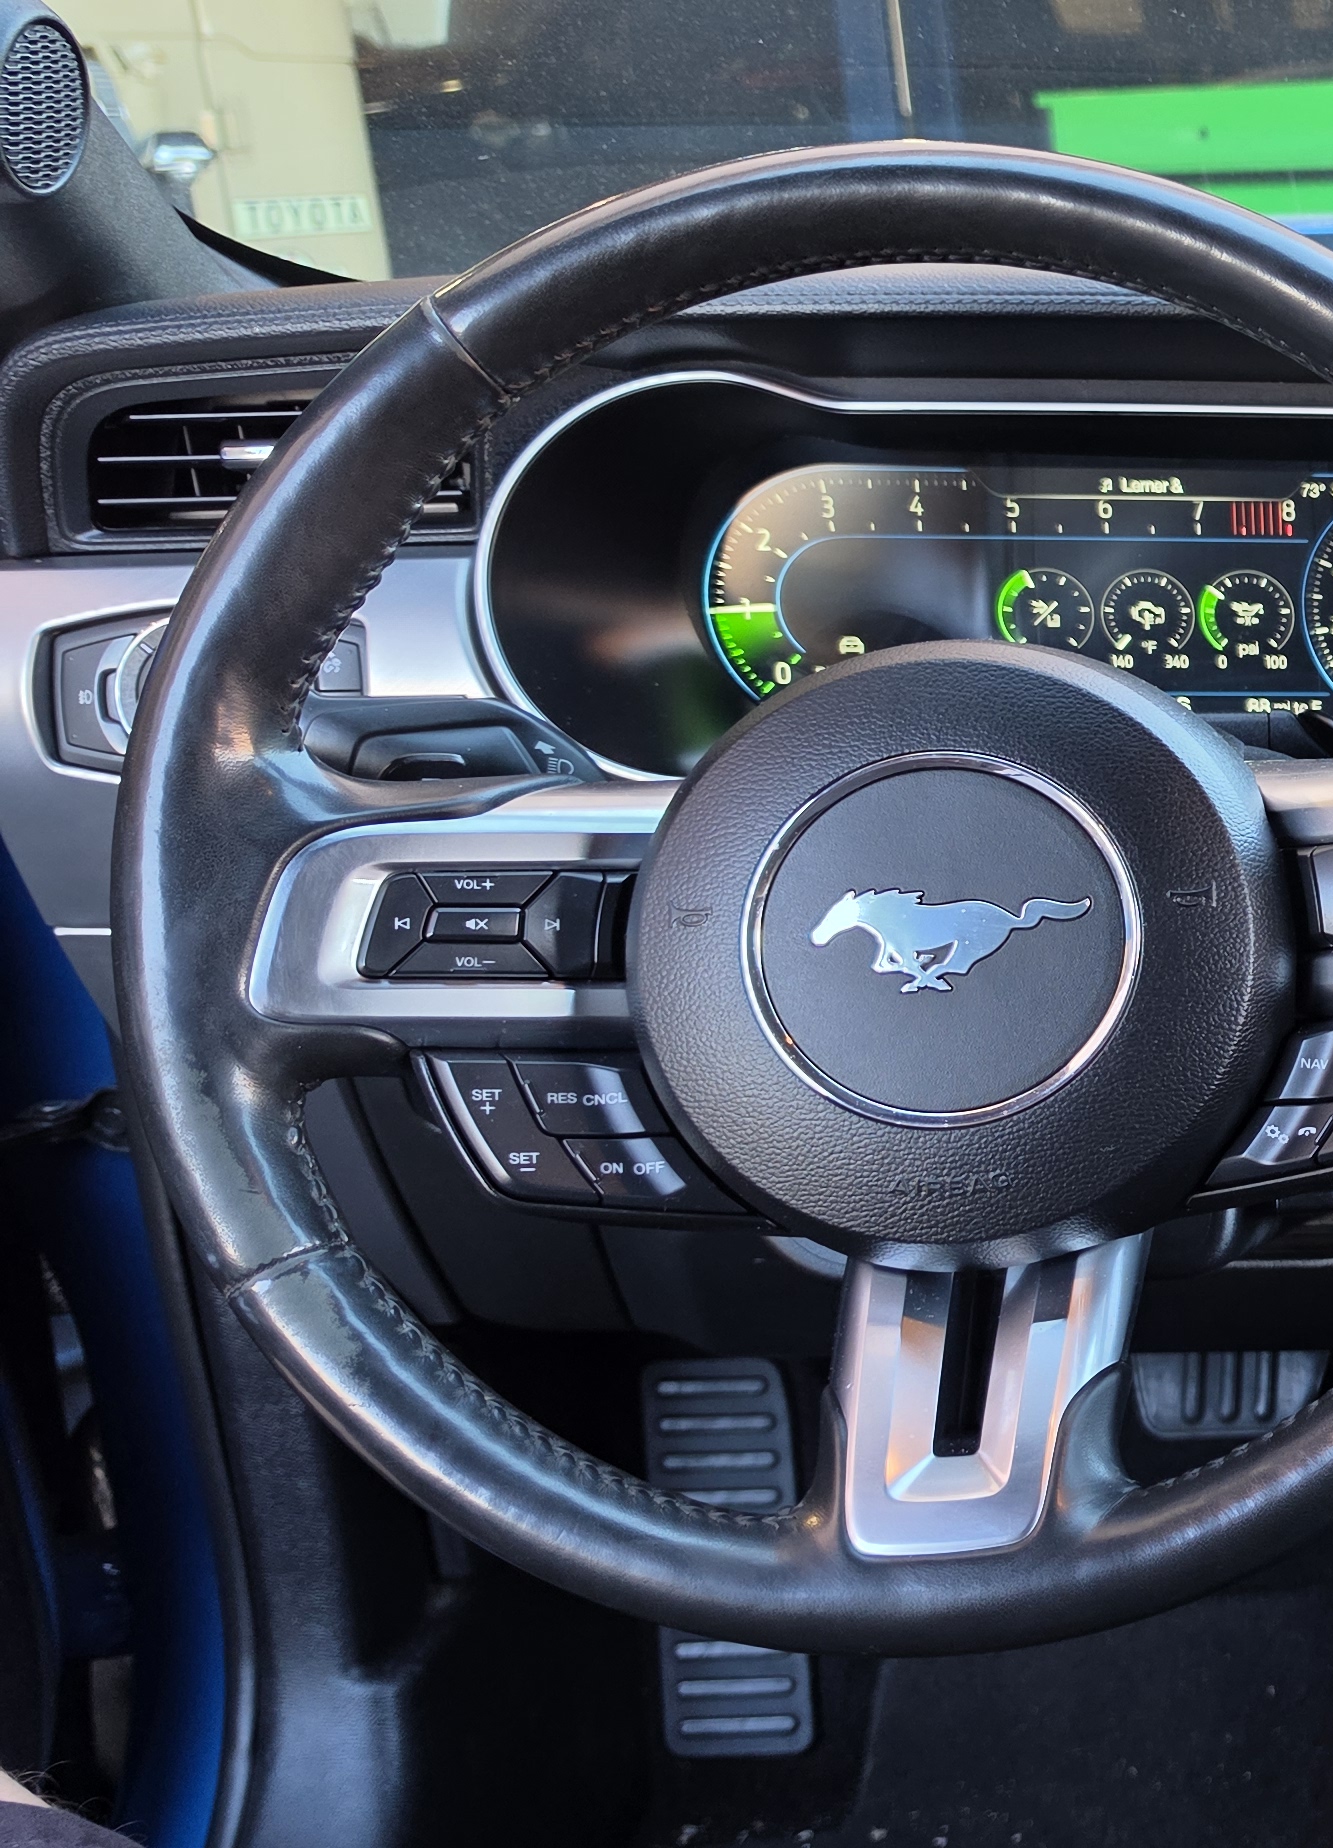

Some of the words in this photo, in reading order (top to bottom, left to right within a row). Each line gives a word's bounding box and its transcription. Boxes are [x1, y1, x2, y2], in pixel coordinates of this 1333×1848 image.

[242, 196, 366, 234] TOYOTA
[1169, 477, 1184, 493] &
[1301, 483, 1326, 498] 73°
[821, 495, 835, 518] 3
[909, 495, 924, 517] 4
[1004, 498, 1020, 518] 5
[1097, 500, 1113, 519] 6
[1192, 501, 1204, 521] 7
[1282, 499, 1296, 521] 8
[756, 529, 772, 551] 2
[1236, 641, 1260, 658] psi
[1110, 654, 1134, 669] 140
[1163, 654, 1190, 669] 340
[1215, 655, 1228, 669] 0
[1263, 655, 1288, 670] 100
[773, 661, 792, 685] 0
[1300, 1057, 1329, 1070] NAV
[471, 1089, 502, 1101] SET
[547, 1092, 578, 1104] RES
[582, 1091, 628, 1106] CNCL
[509, 1152, 540, 1164] SET
[600, 1162, 624, 1174] ON
[633, 1160, 665, 1175] OFF
[889, 1168, 1013, 1197] AIRBAG
